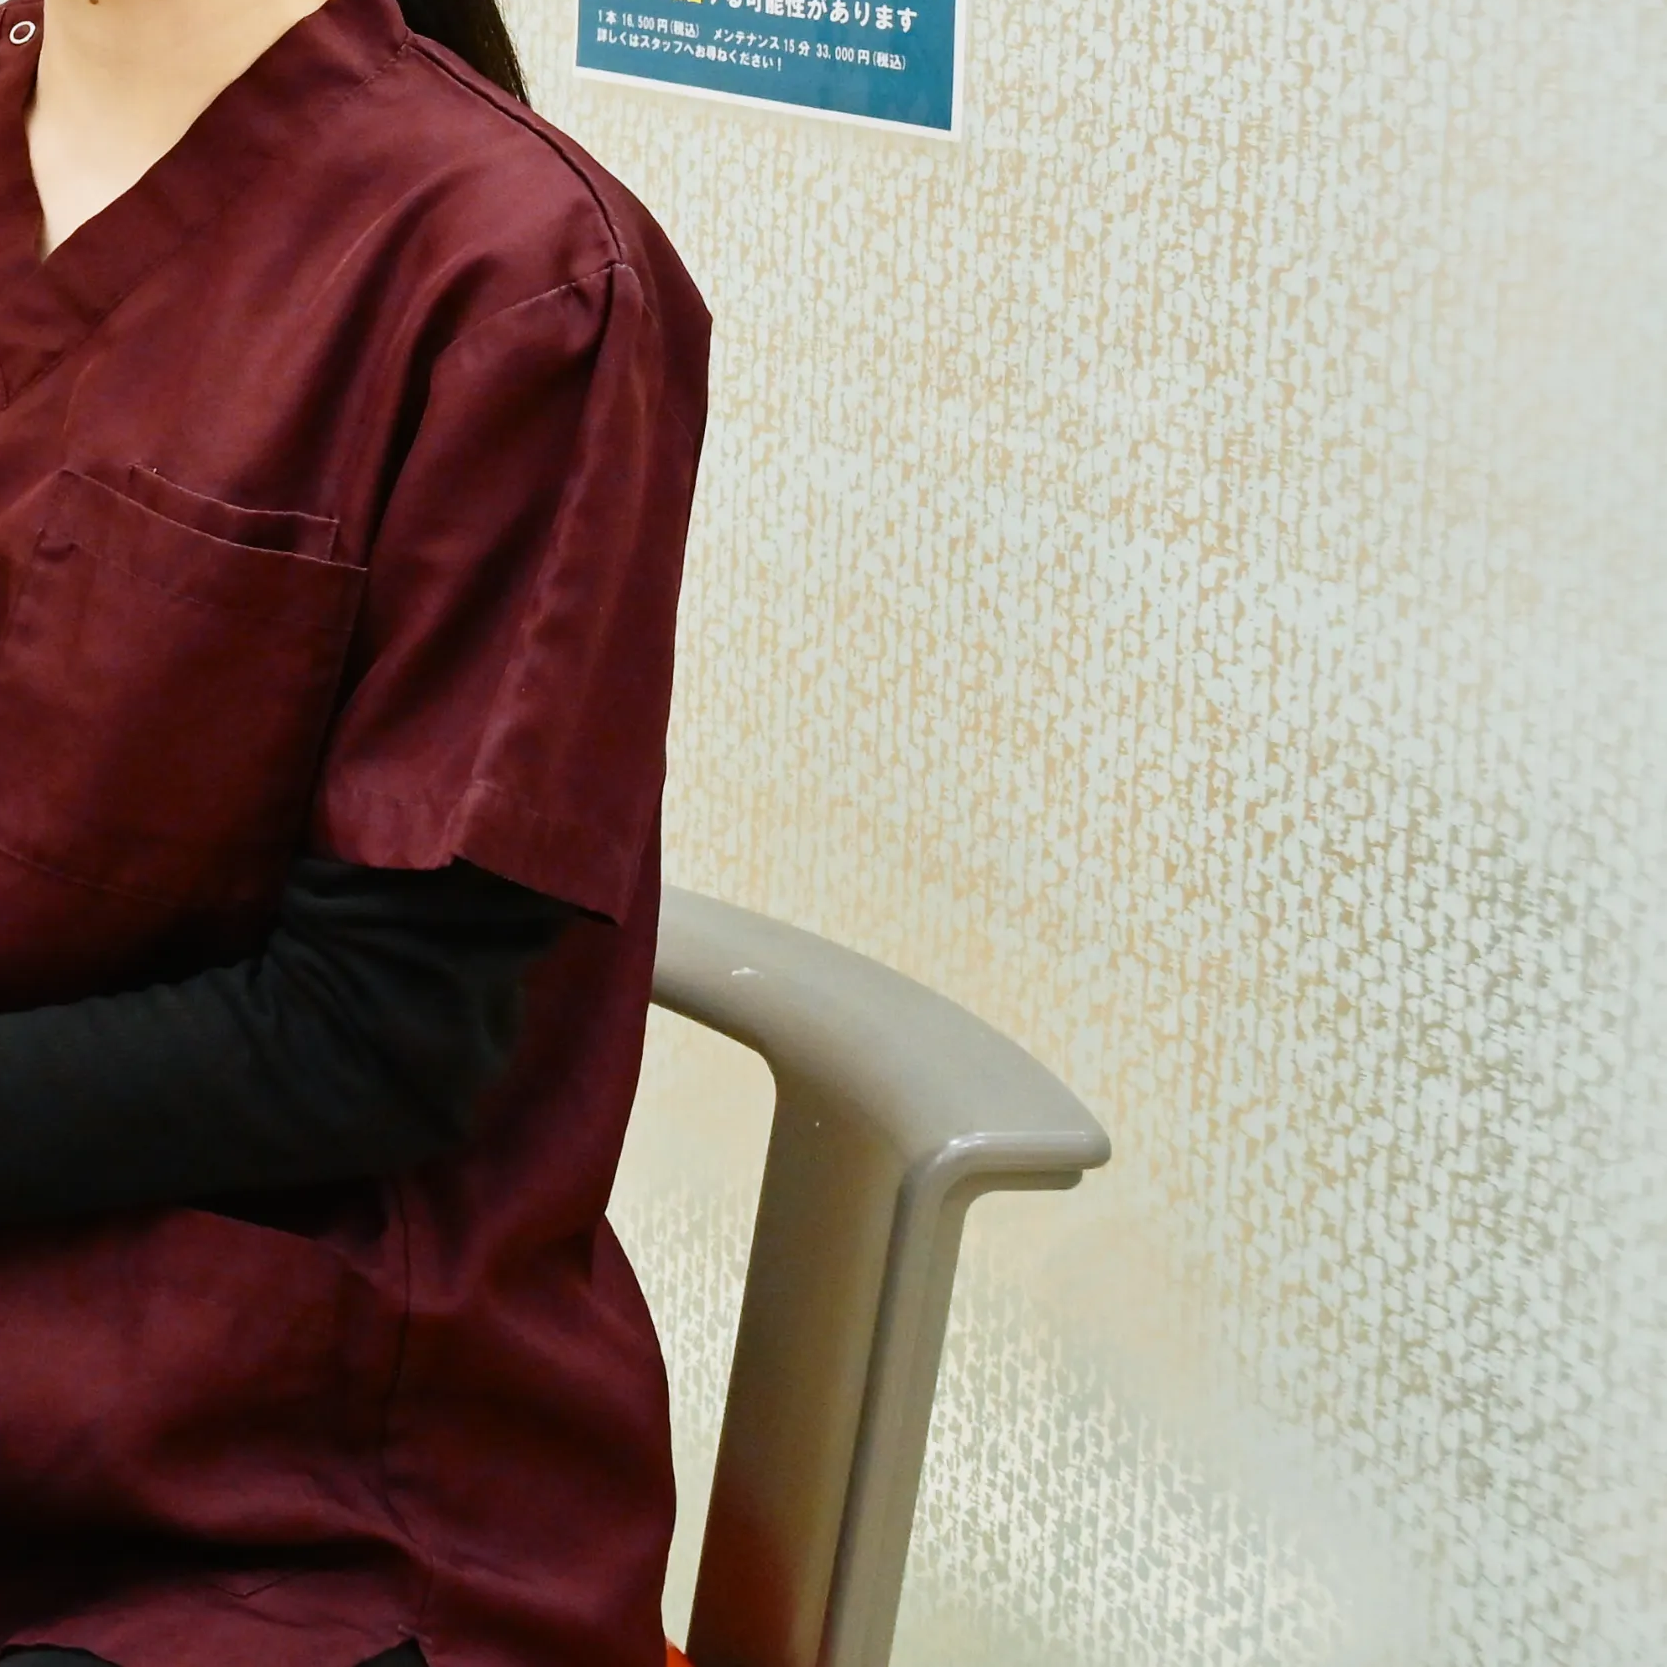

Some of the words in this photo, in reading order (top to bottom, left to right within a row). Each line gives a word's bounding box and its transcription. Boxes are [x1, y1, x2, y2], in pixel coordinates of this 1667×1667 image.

[713, 28, 781, 50] メンテナンス
